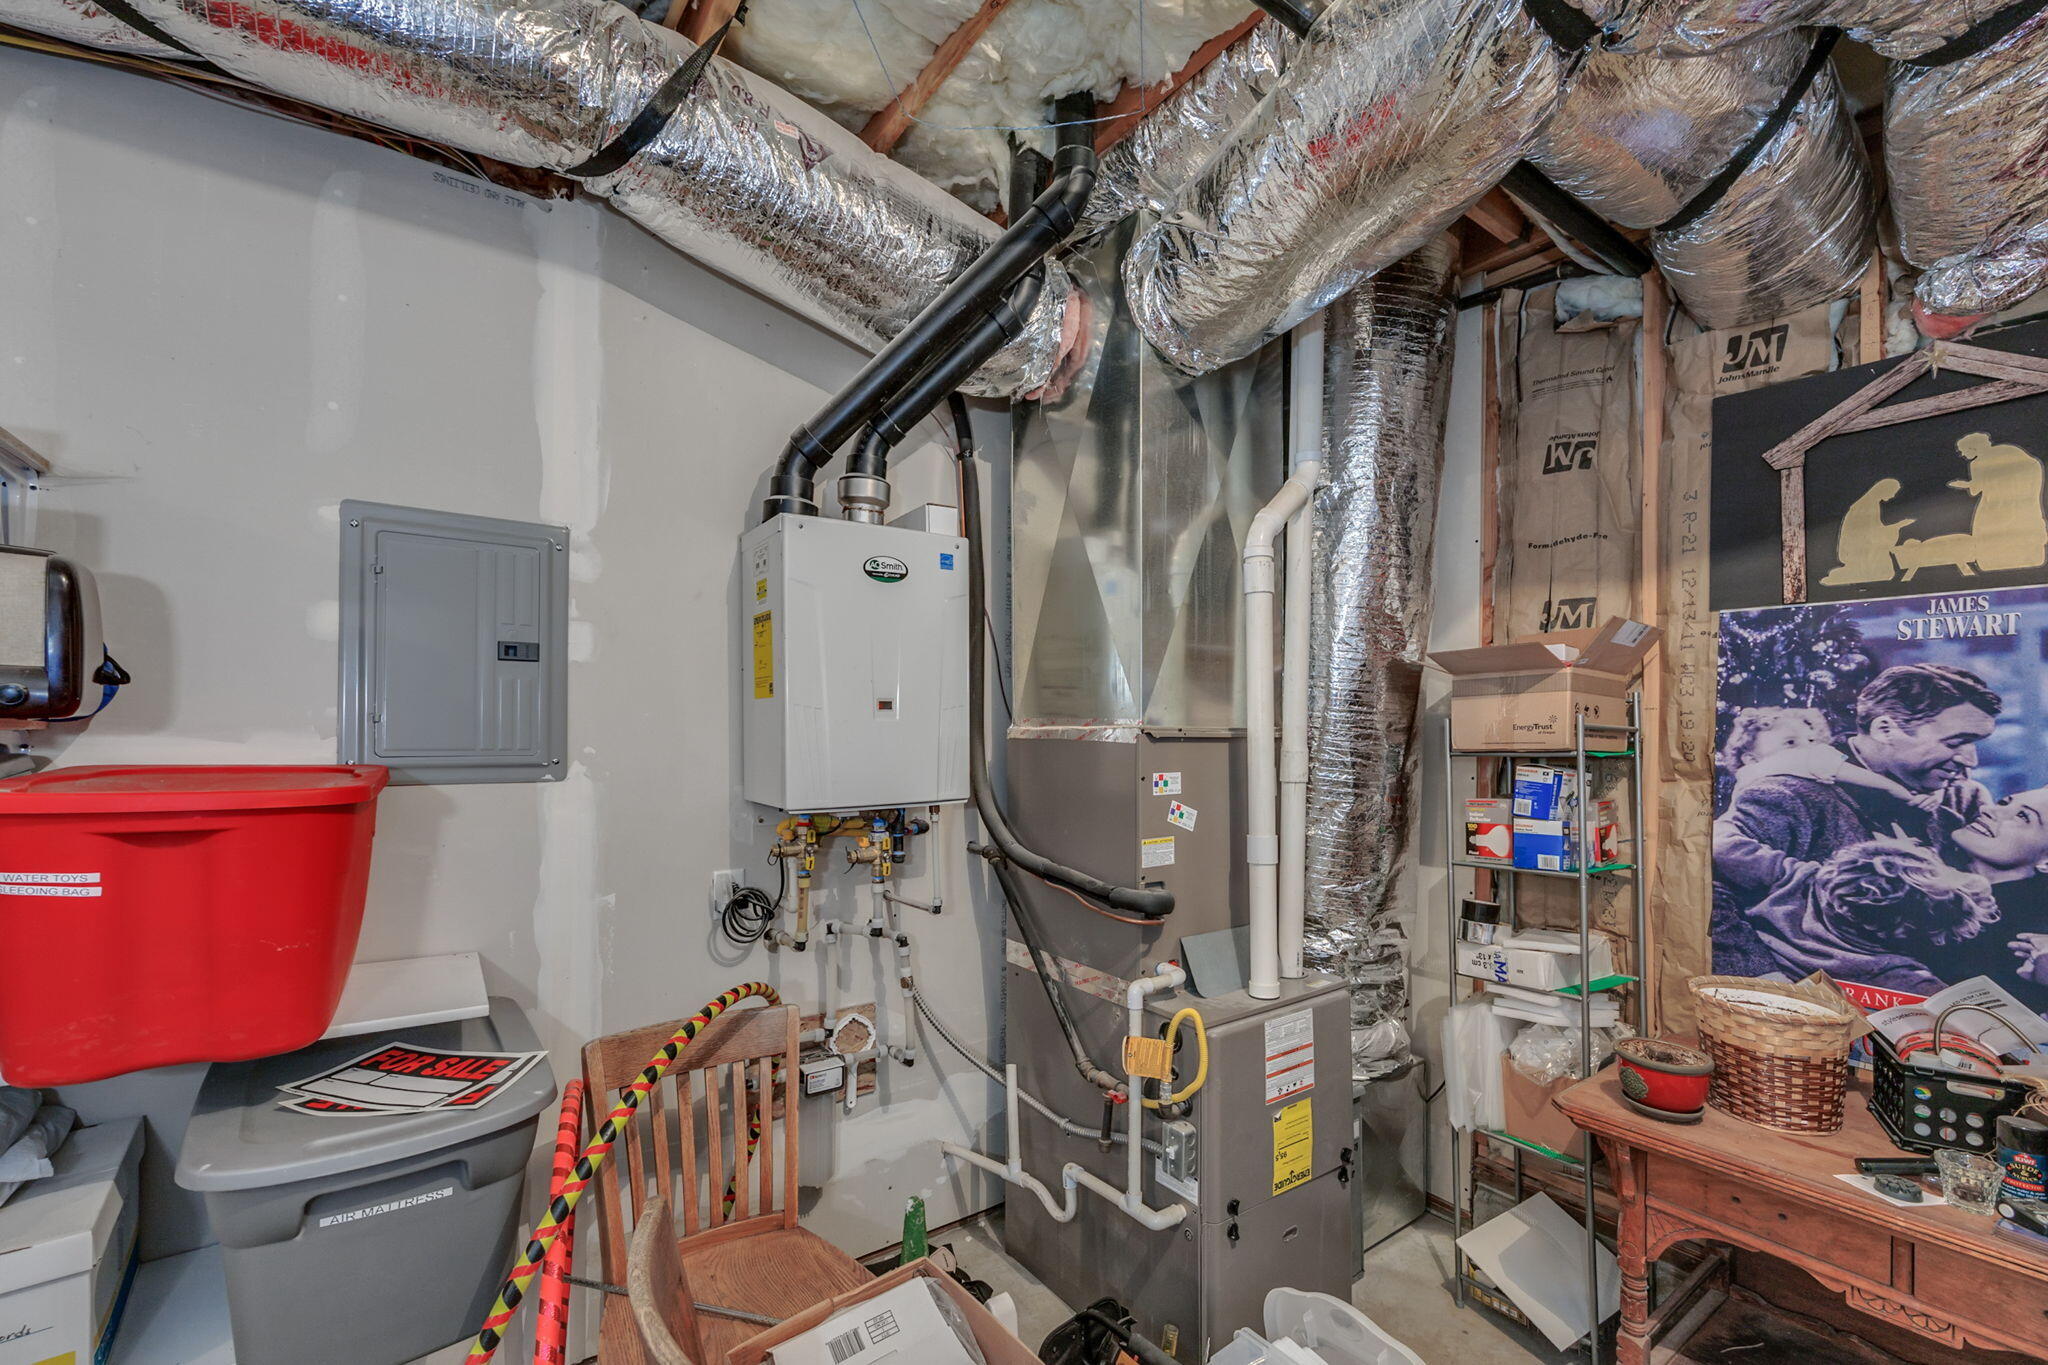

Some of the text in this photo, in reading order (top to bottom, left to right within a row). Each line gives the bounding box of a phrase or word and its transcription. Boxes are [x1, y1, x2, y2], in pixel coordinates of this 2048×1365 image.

[1722, 323, 1789, 374] JM
[1682, 511, 1698, 556] R-21
[881, 561, 903, 571] Smith
[1681, 568, 1697, 652] 12/13/11
[1926, 595, 1990, 616] JAMES
[1897, 612, 2022, 641] STEWART
[1680, 710, 1697, 763] 19:20
[3, 874, 88, 882] WATER TOYS
[62, 887, 90, 897] BAG
[360, 1050, 511, 1080] FOR SALE
[2009, 1162, 2040, 1175] SUEDE
[329, 1189, 444, 1225] AIR MATTRESS
